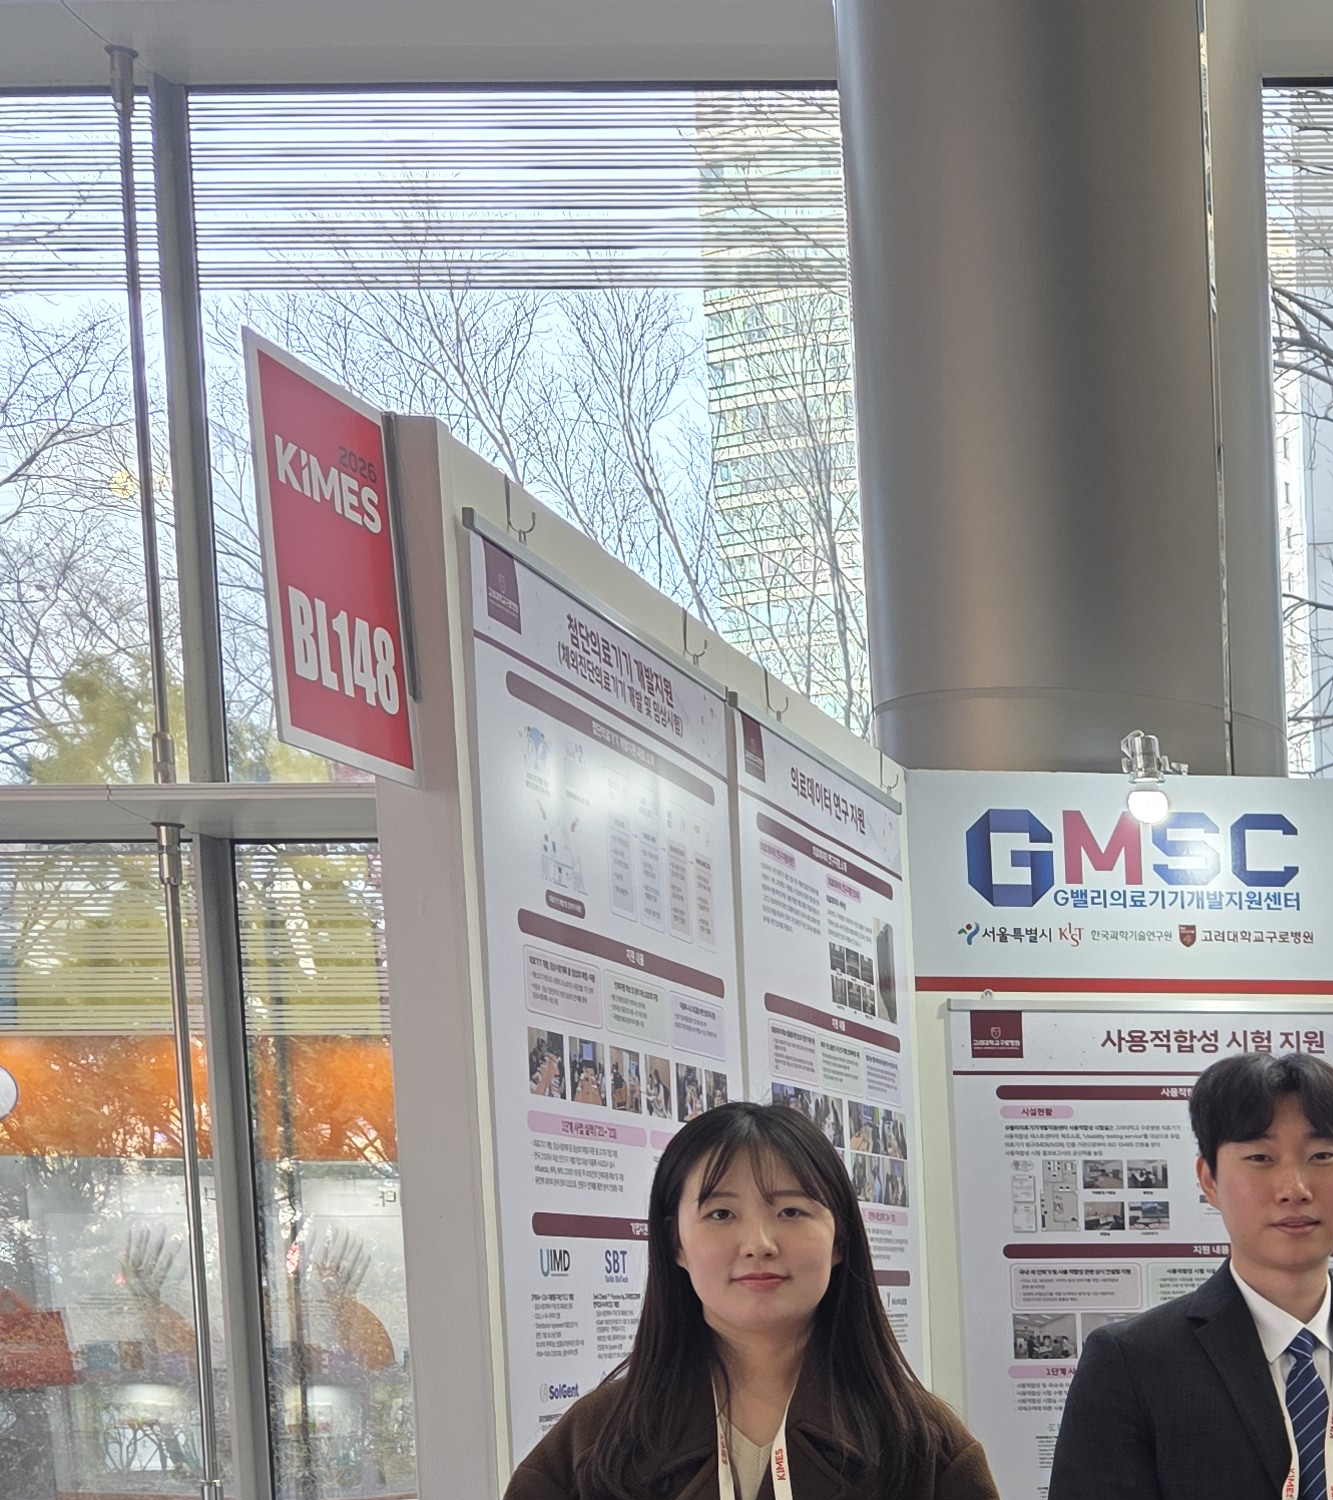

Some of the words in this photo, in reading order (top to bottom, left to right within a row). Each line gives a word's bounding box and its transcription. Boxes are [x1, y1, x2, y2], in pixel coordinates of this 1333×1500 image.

[338, 446, 377, 484] 2026
[288, 586, 400, 715] BL148
[566, 613, 634, 684] 첨단의료기기
[634, 659, 674, 709] 개발지원
[790, 766, 833, 816] 의료데이터
[833, 791, 850, 825] 연구
[966, 808, 1300, 907] GMSC
[1053, 888, 1302, 911] G밸리의료기기개발지원센터
[982, 926, 1053, 944] 서울특별시
[1058, 922, 1085, 947] KIST
[1091, 928, 1173, 943] 한국과학기술연구원
[1201, 929, 1315, 944] 고려대학교구로병원
[1101, 1029, 1219, 1054] 사용적합성
[1226, 1030, 1272, 1054] 시험
[1279, 1030, 1325, 1054] 지원
[1021, 1108, 1053, 1117] 시설현황
[604, 1249, 628, 1275] SBT
[549, 1383, 580, 1400] SolGent
